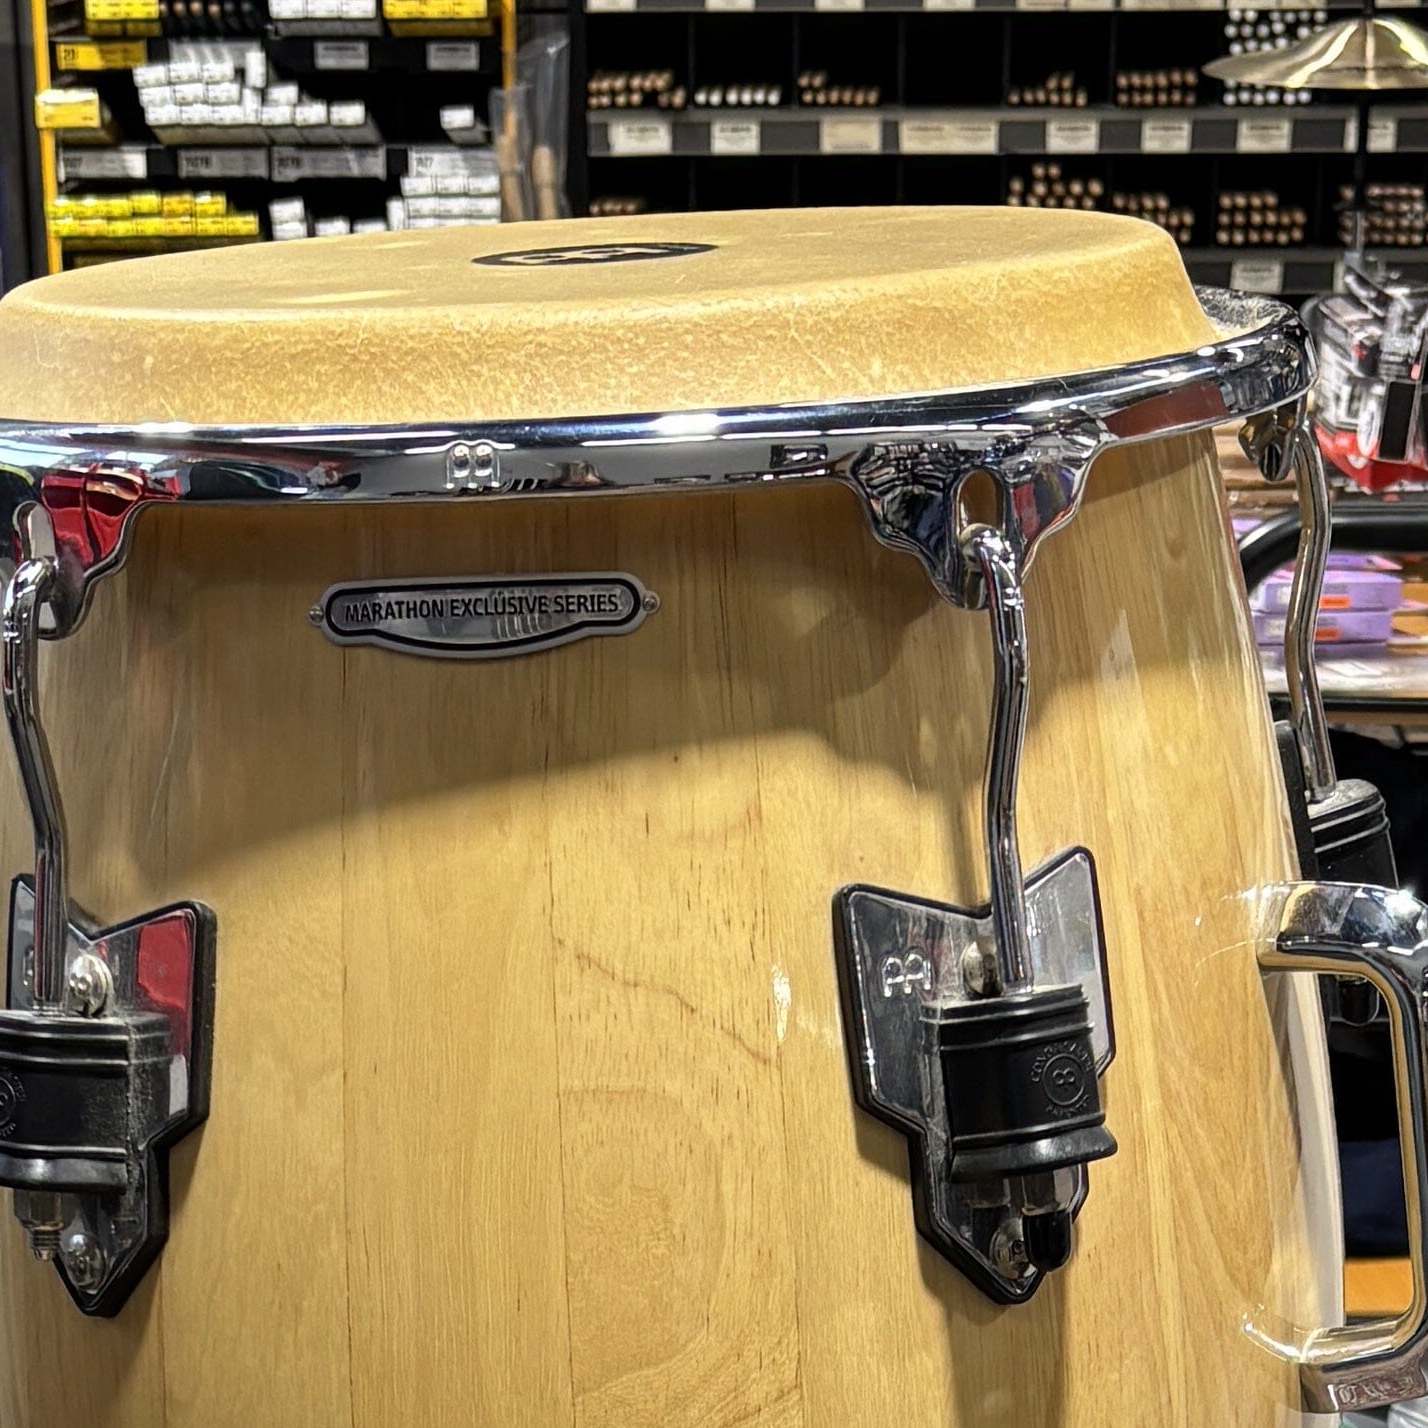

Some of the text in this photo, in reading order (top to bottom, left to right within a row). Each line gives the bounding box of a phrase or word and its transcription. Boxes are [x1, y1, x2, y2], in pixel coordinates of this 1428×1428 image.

[345, 593, 619, 623] MARATHON EXCLUSIVE SERIES
